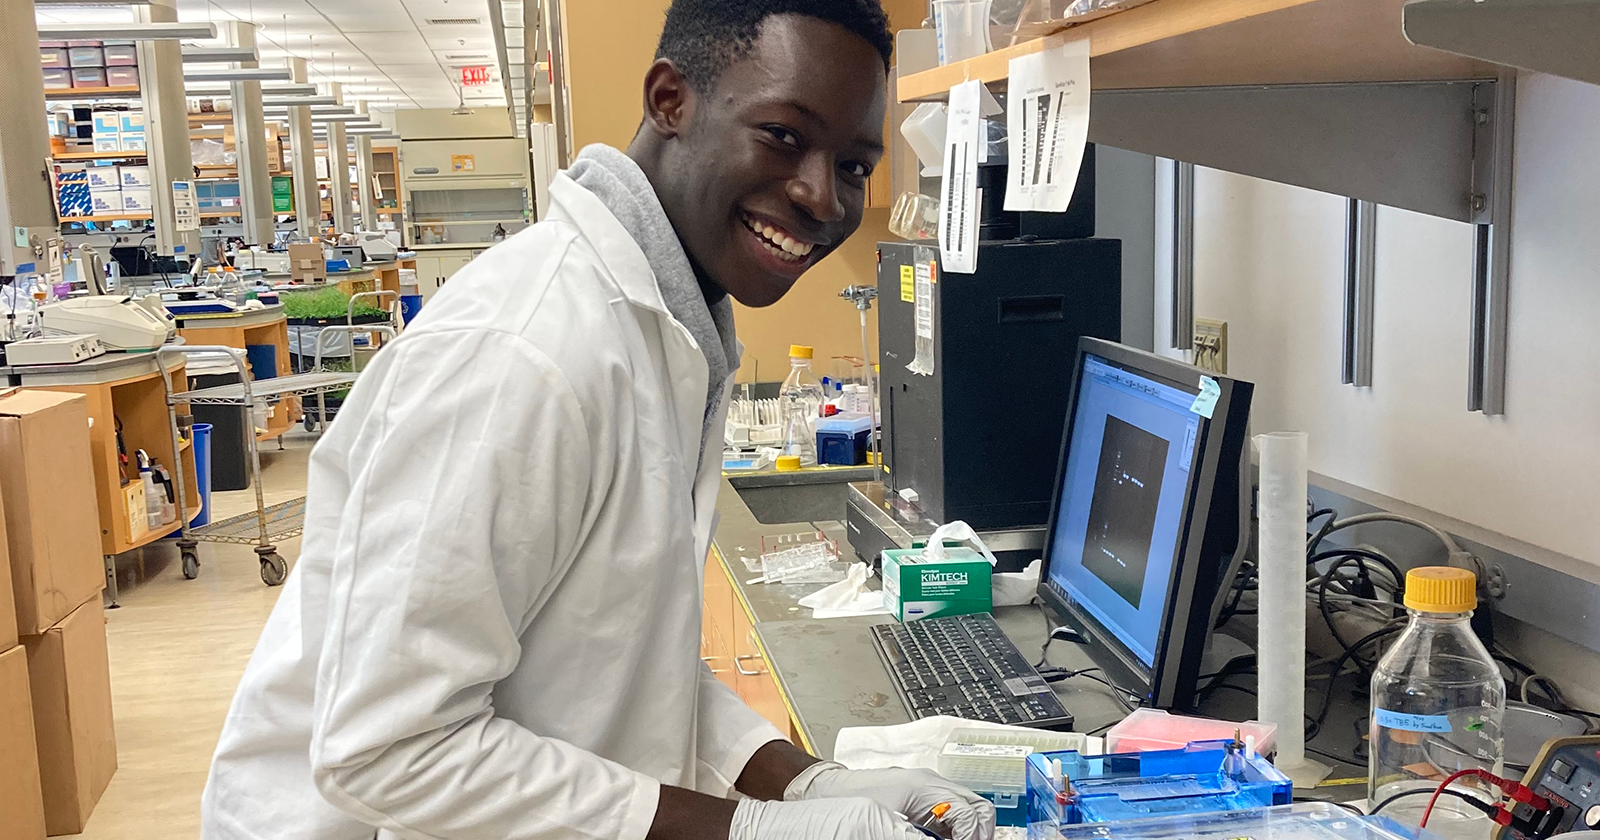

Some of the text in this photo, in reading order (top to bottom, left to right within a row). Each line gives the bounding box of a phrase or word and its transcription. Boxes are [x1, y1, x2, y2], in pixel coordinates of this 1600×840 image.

[462, 67, 486, 85] EXIT
[921, 572, 968, 582] KIMTECH
[1394, 717, 1410, 726] TBE
[1543, 790, 1569, 808] WARNING
